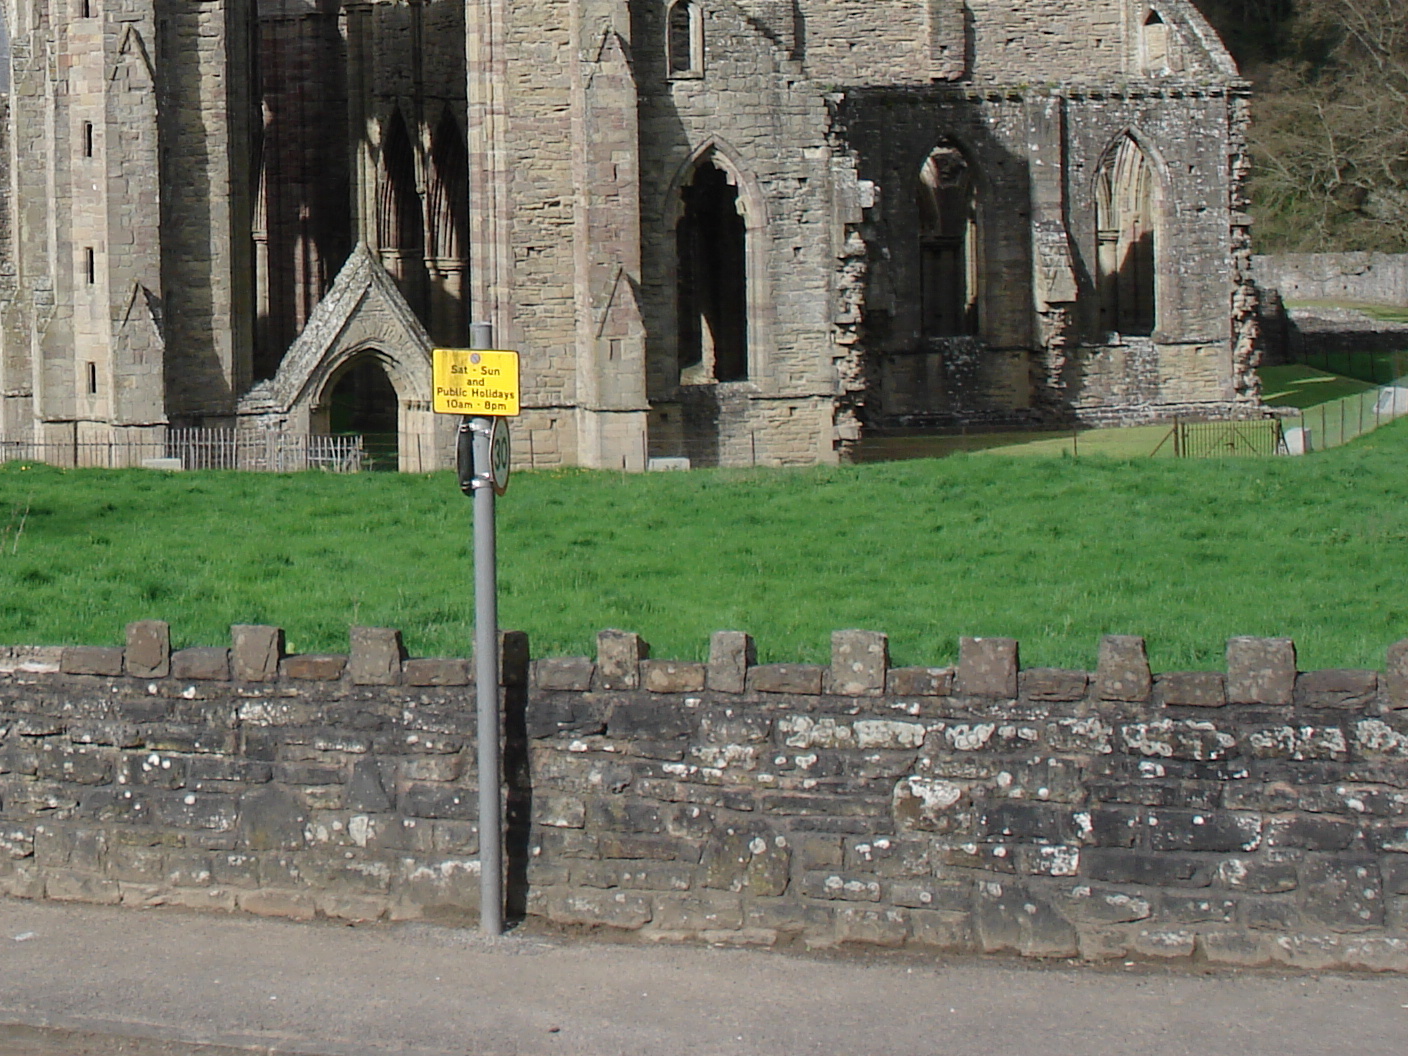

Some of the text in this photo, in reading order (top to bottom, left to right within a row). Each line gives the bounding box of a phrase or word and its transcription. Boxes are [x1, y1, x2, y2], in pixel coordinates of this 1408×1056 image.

[451, 365, 468, 375] Sat
[481, 366, 500, 375] Sun
[467, 378, 485, 386] and
[437, 387, 515, 400] Public Holidays
[446, 400, 473, 409] 10am
[484, 401, 507, 411] 8pm
[494, 437, 507, 471] 30
